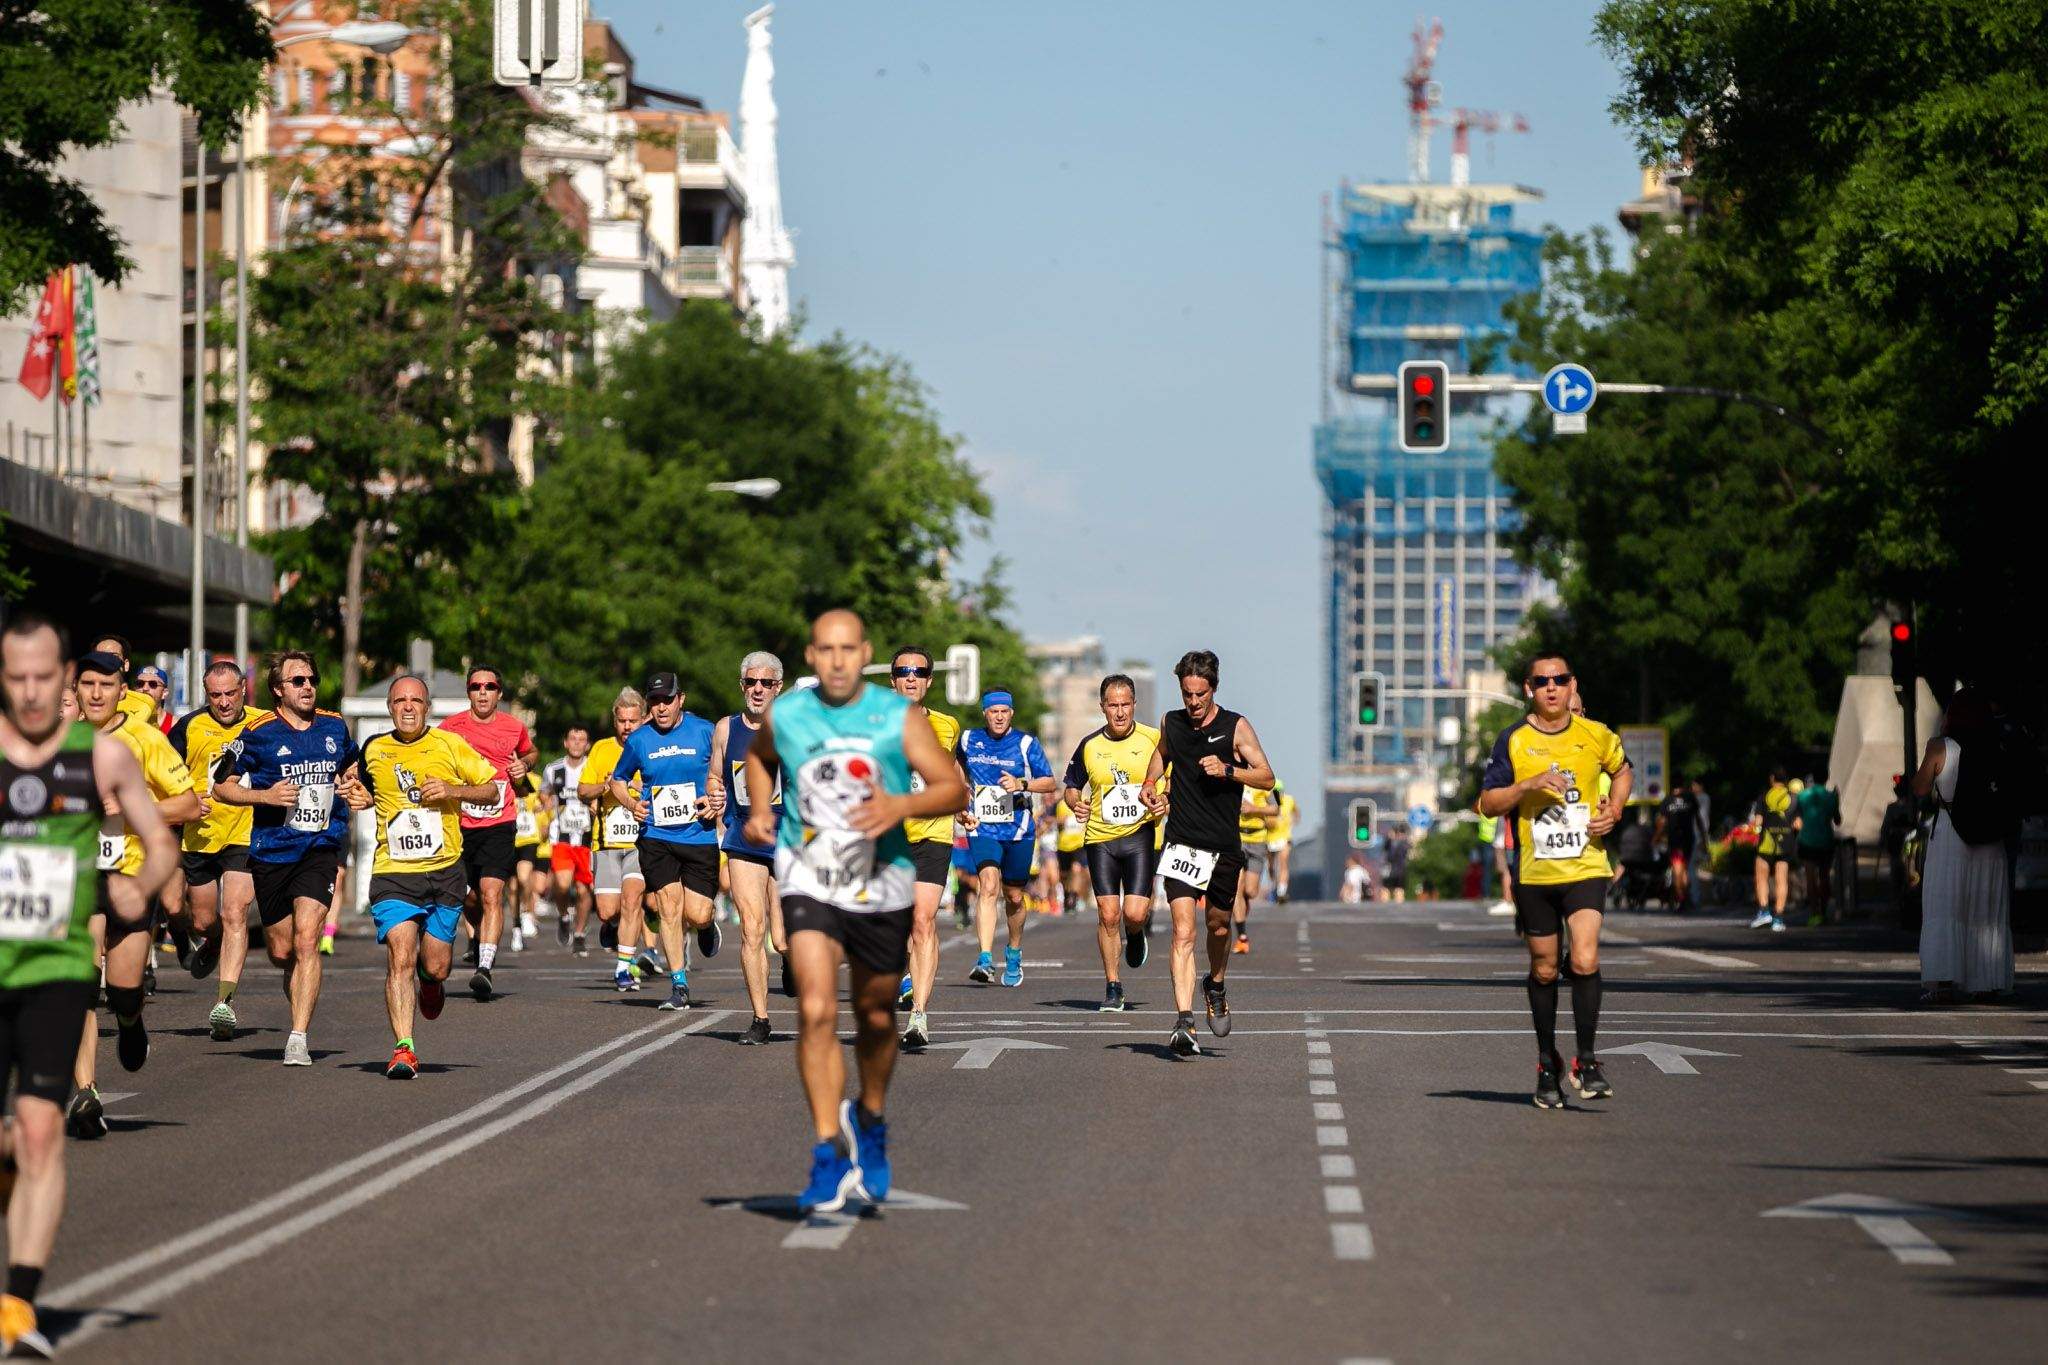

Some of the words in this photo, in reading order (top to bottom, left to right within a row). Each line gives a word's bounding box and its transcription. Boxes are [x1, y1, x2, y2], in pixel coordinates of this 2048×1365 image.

[281, 760, 336, 778] Emirates
[410, 791, 420, 800] 13
[295, 809, 326, 823] 3534
[662, 805, 689, 818] 1654
[982, 804, 1005, 815] 1368
[1112, 805, 1137, 818] 3718
[613, 824, 638, 835] 3878
[398, 834, 432, 850] 1634
[1547, 831, 1581, 848] 4341
[1172, 858, 1200, 879] 3071
